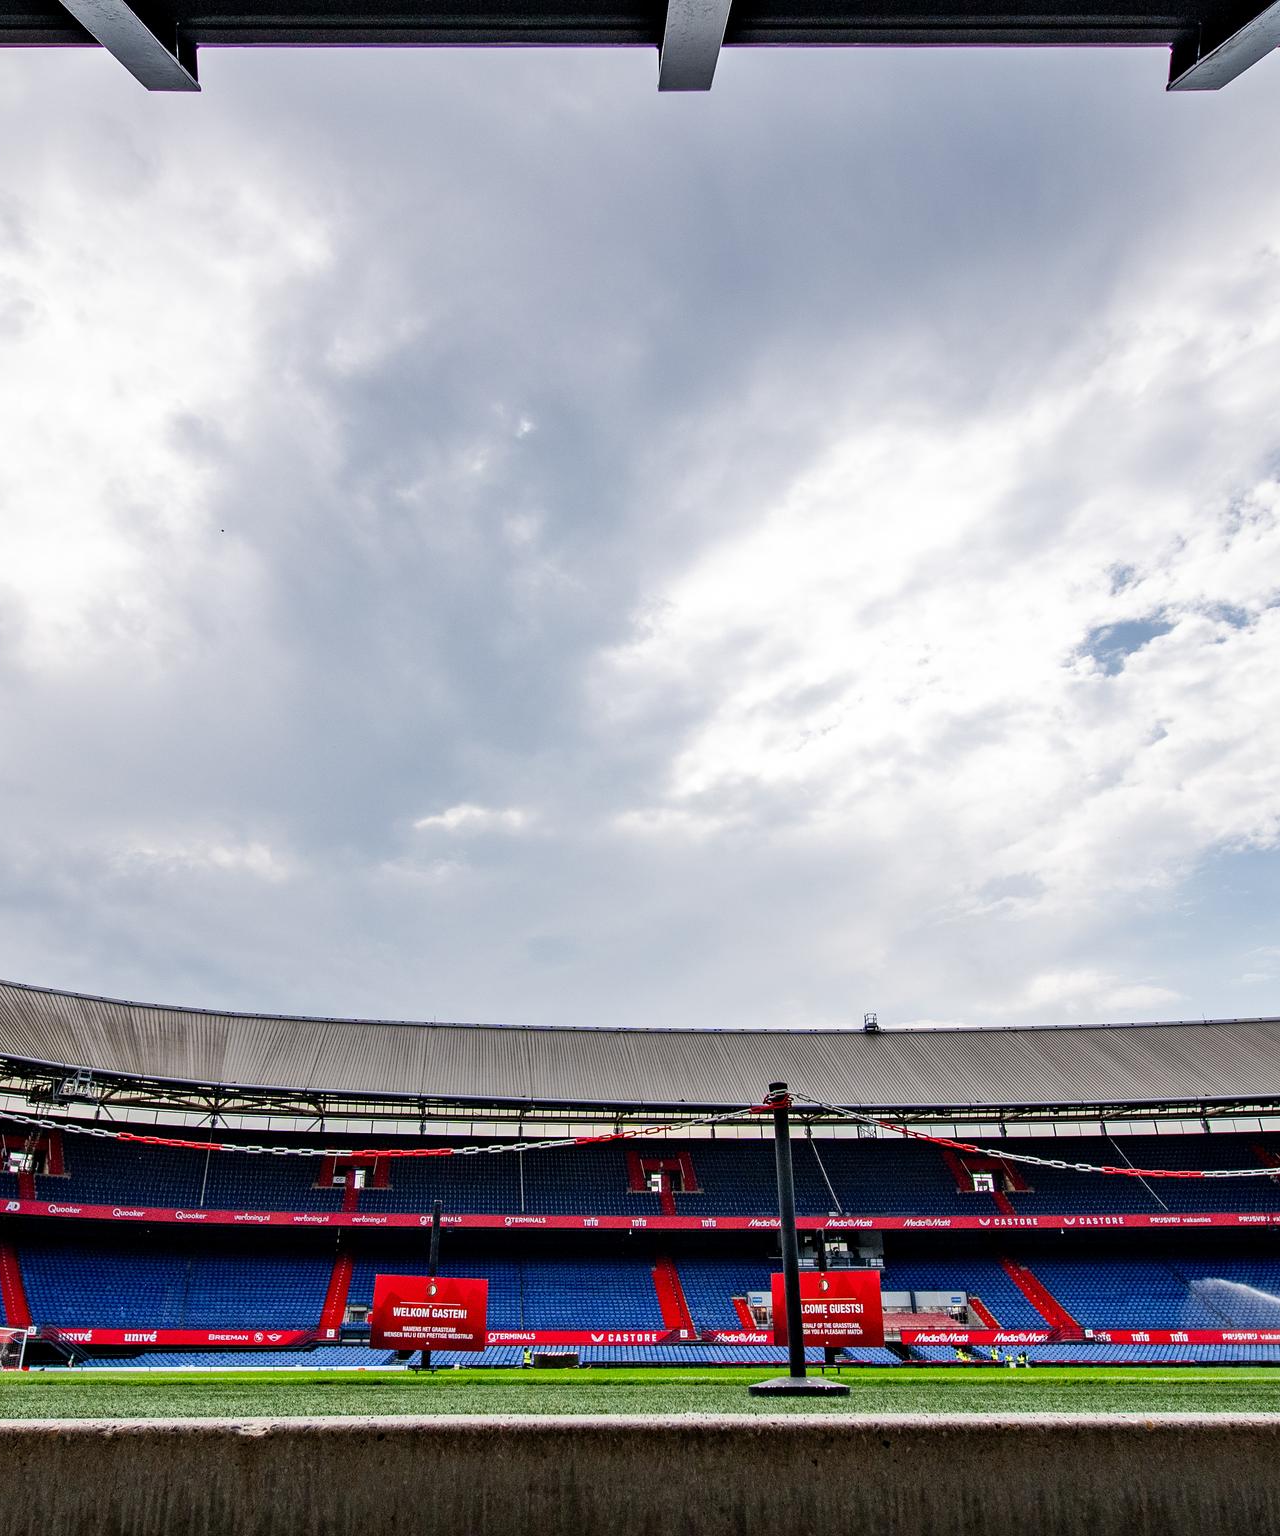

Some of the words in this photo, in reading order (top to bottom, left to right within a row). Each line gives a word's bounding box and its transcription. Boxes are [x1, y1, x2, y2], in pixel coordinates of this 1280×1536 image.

[5, 1201, 20, 1211] AD
[48, 1204, 81, 1214] Quooker
[113, 1208, 145, 1217] Quooker
[175, 1211, 207, 1220] Quooker
[393, 1307, 429, 1317] WELKOM
[432, 1308, 467, 1319] GASTEN!
[801, 1304, 827, 1313] LCOME
[830, 1304, 864, 1314] GUESTS!
[124, 1331, 157, 1342] univé
[608, 1334, 657, 1342] CASTORE
[1131, 1332, 1150, 1341] TOTO
[1170, 1332, 1188, 1341] TOTO
